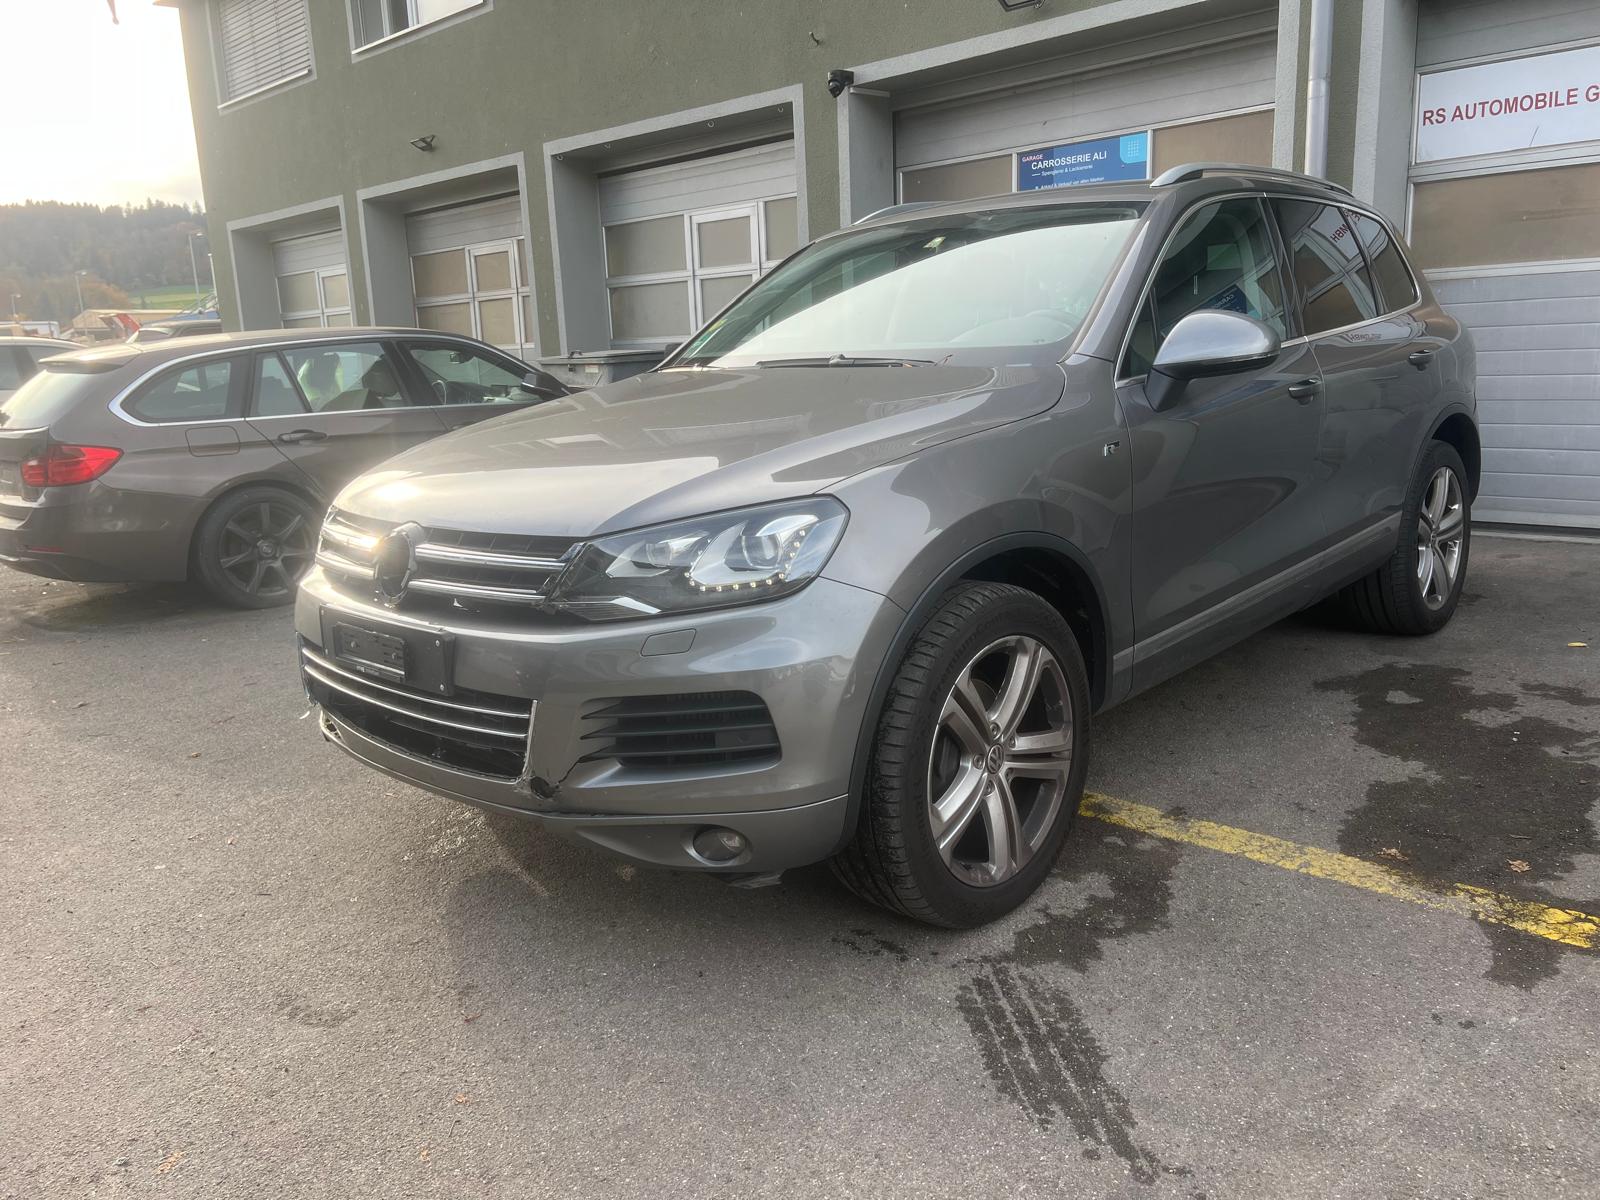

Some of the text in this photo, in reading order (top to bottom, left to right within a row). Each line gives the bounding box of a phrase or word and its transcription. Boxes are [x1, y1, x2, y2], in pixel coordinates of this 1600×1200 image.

[1422, 84, 1600, 126] RS AUTOMOBILE G
[1022, 153, 1044, 162] GARAGE
[1031, 150, 1107, 170] CARROSSERIE ALI
